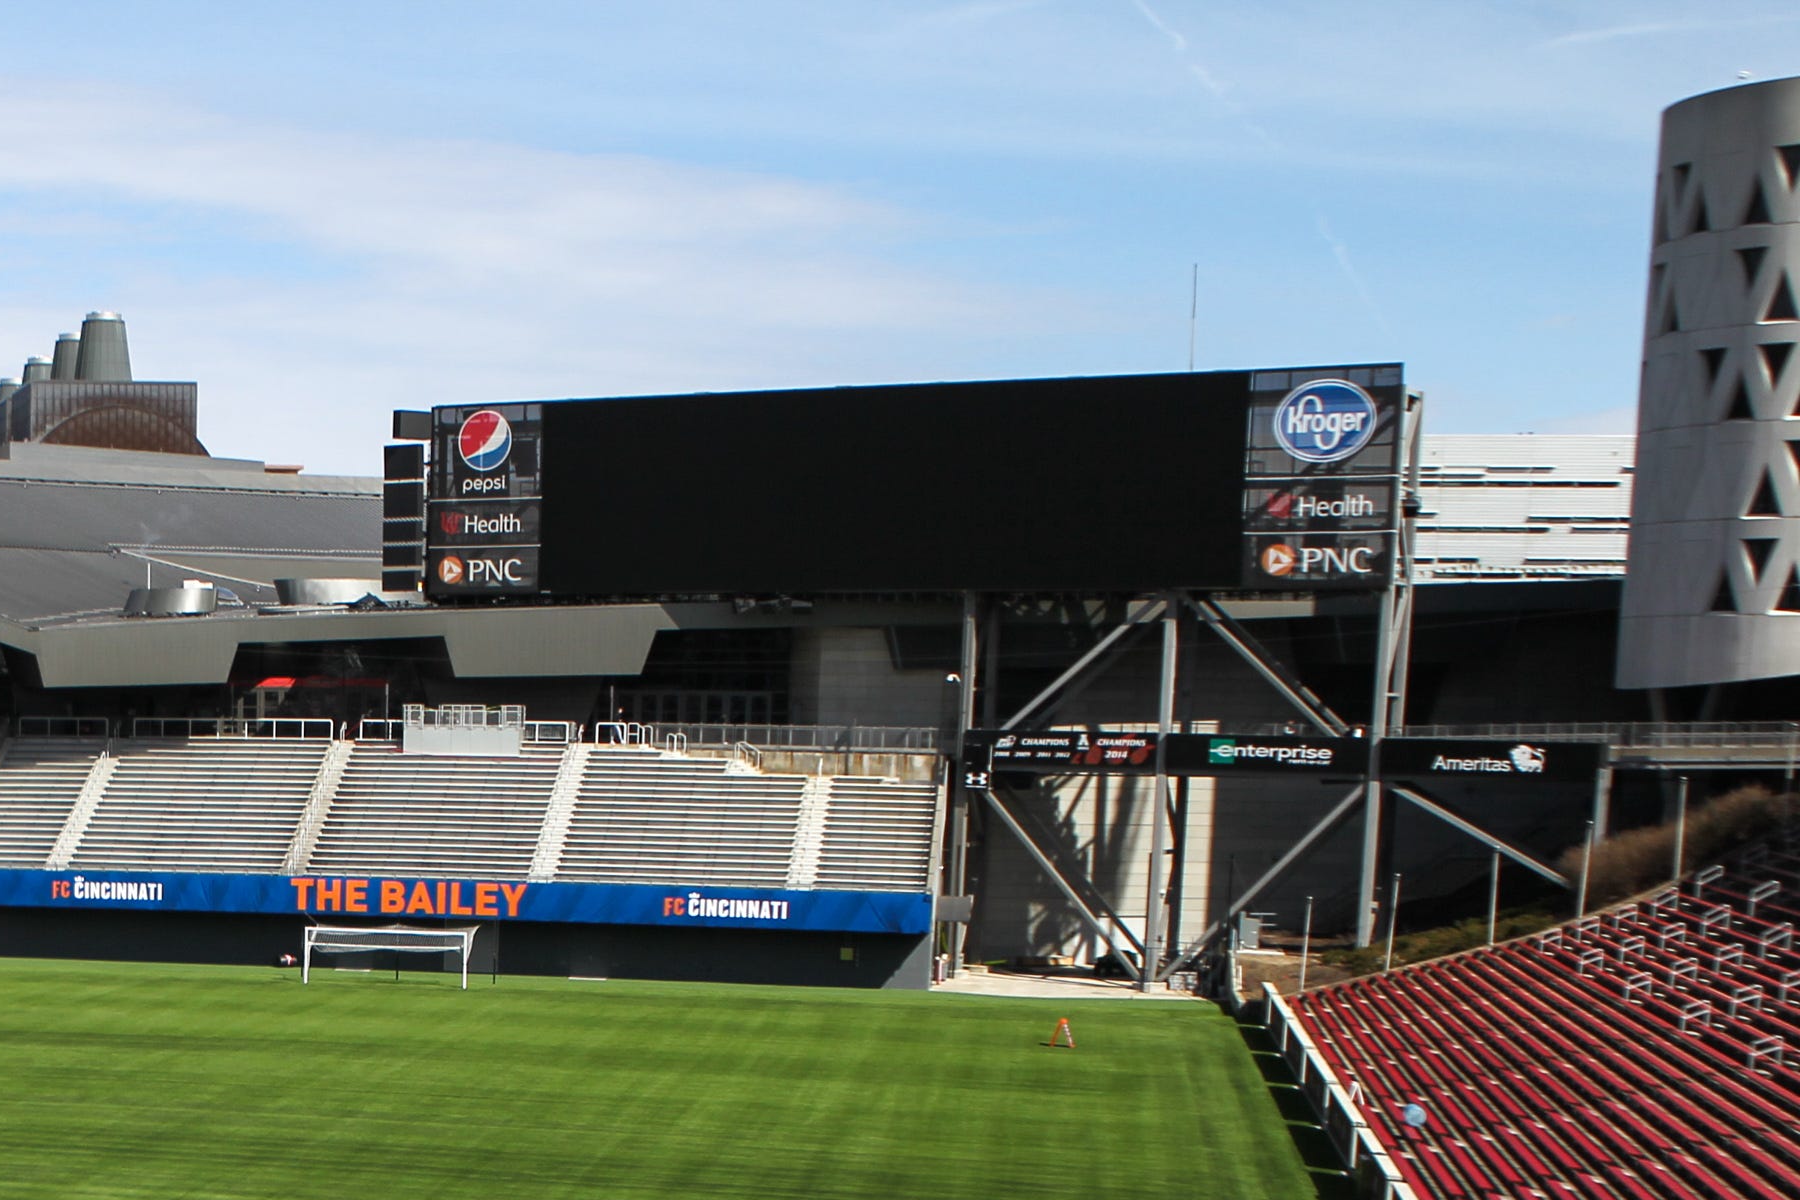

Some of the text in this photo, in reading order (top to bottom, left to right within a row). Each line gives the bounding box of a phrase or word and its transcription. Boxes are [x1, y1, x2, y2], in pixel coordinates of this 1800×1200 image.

[1287, 395, 1369, 450] Kroger
[462, 474, 506, 494] pepsi
[1298, 494, 1374, 517] Health
[464, 513, 521, 533] Health
[467, 558, 522, 582] PNC
[1300, 547, 1373, 573] PNC
[1021, 738, 1070, 746] CHAMPIONS
[1096, 738, 1147, 747] CHAMPIONS
[1104, 750, 1128, 759] 2014
[1211, 744, 1333, 762] enterprise
[1431, 755, 1512, 772] Ameritas
[52, 880, 163, 901] FC CINCINNATI
[290, 878, 528, 917] THE BAILEY
[663, 897, 789, 920] FC CINCINNATI
